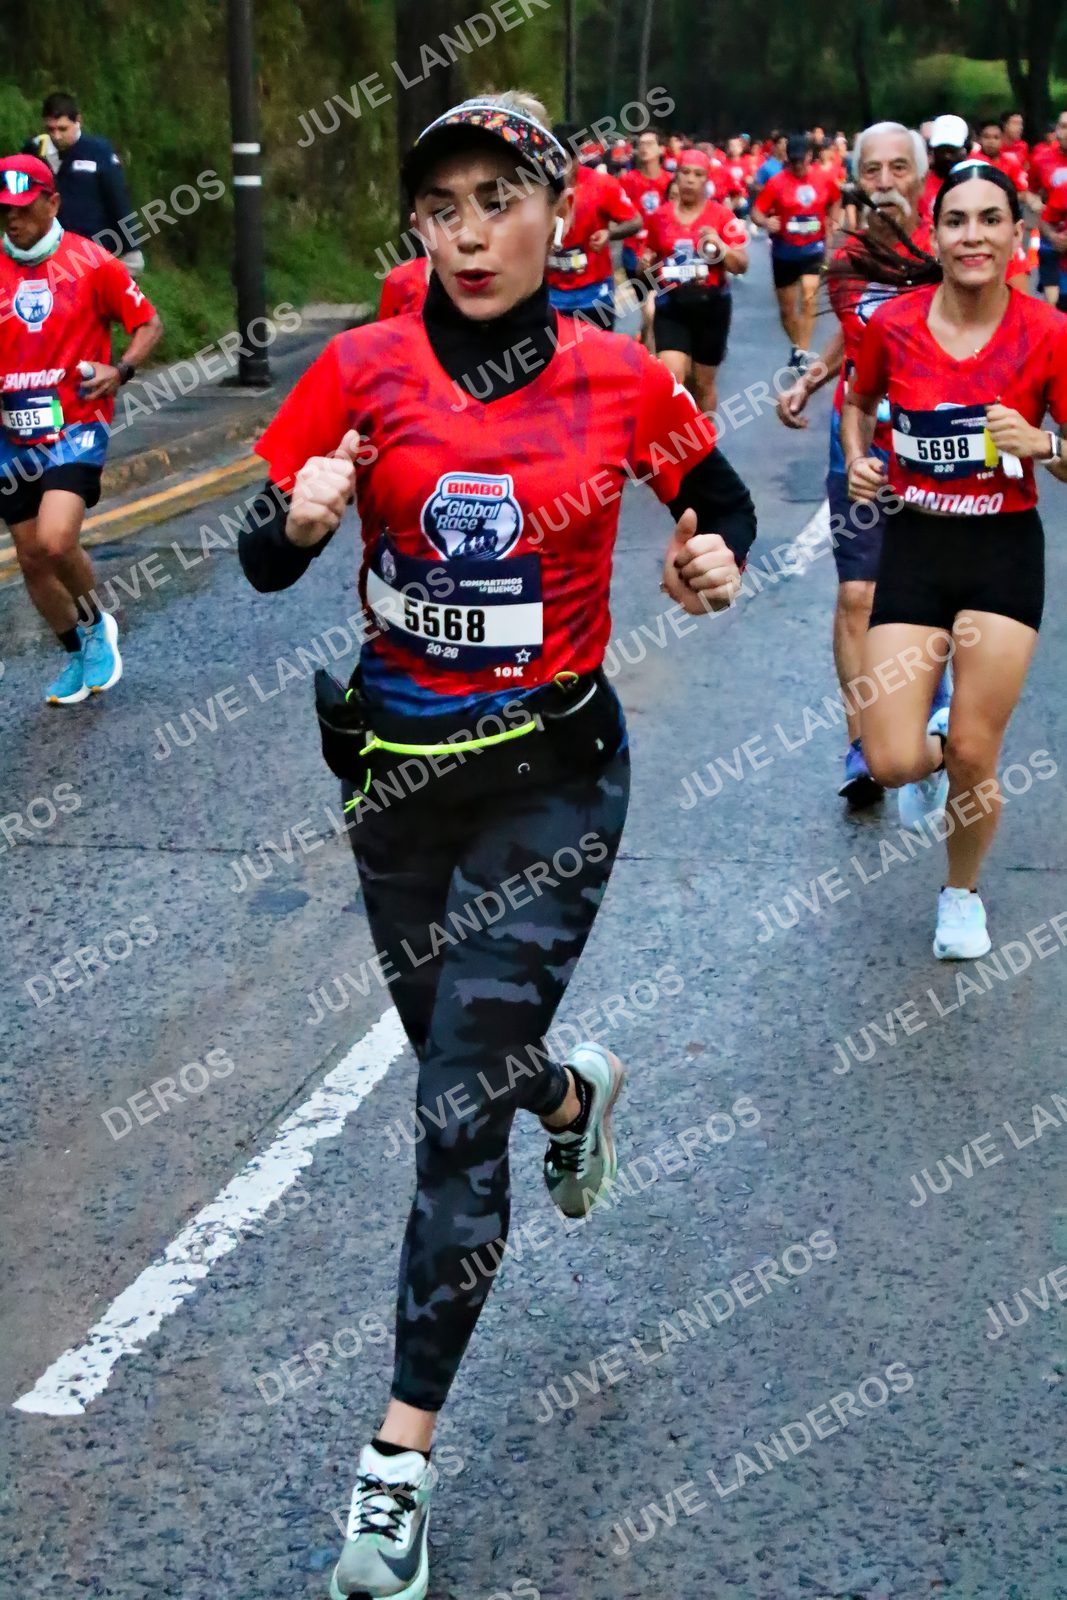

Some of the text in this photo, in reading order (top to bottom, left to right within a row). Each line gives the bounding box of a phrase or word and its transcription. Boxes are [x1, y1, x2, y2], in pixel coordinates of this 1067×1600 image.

[9, 410, 40, 427] 5635
[917, 437, 970, 460] 5698
[447, 482, 503, 496] BIMBO
[905, 485, 1004, 515] SANTIAGO
[447, 501, 500, 519] Global
[436, 515, 478, 530] Race
[404, 598, 485, 643] 5568
[494, 667, 524, 677] 10K
